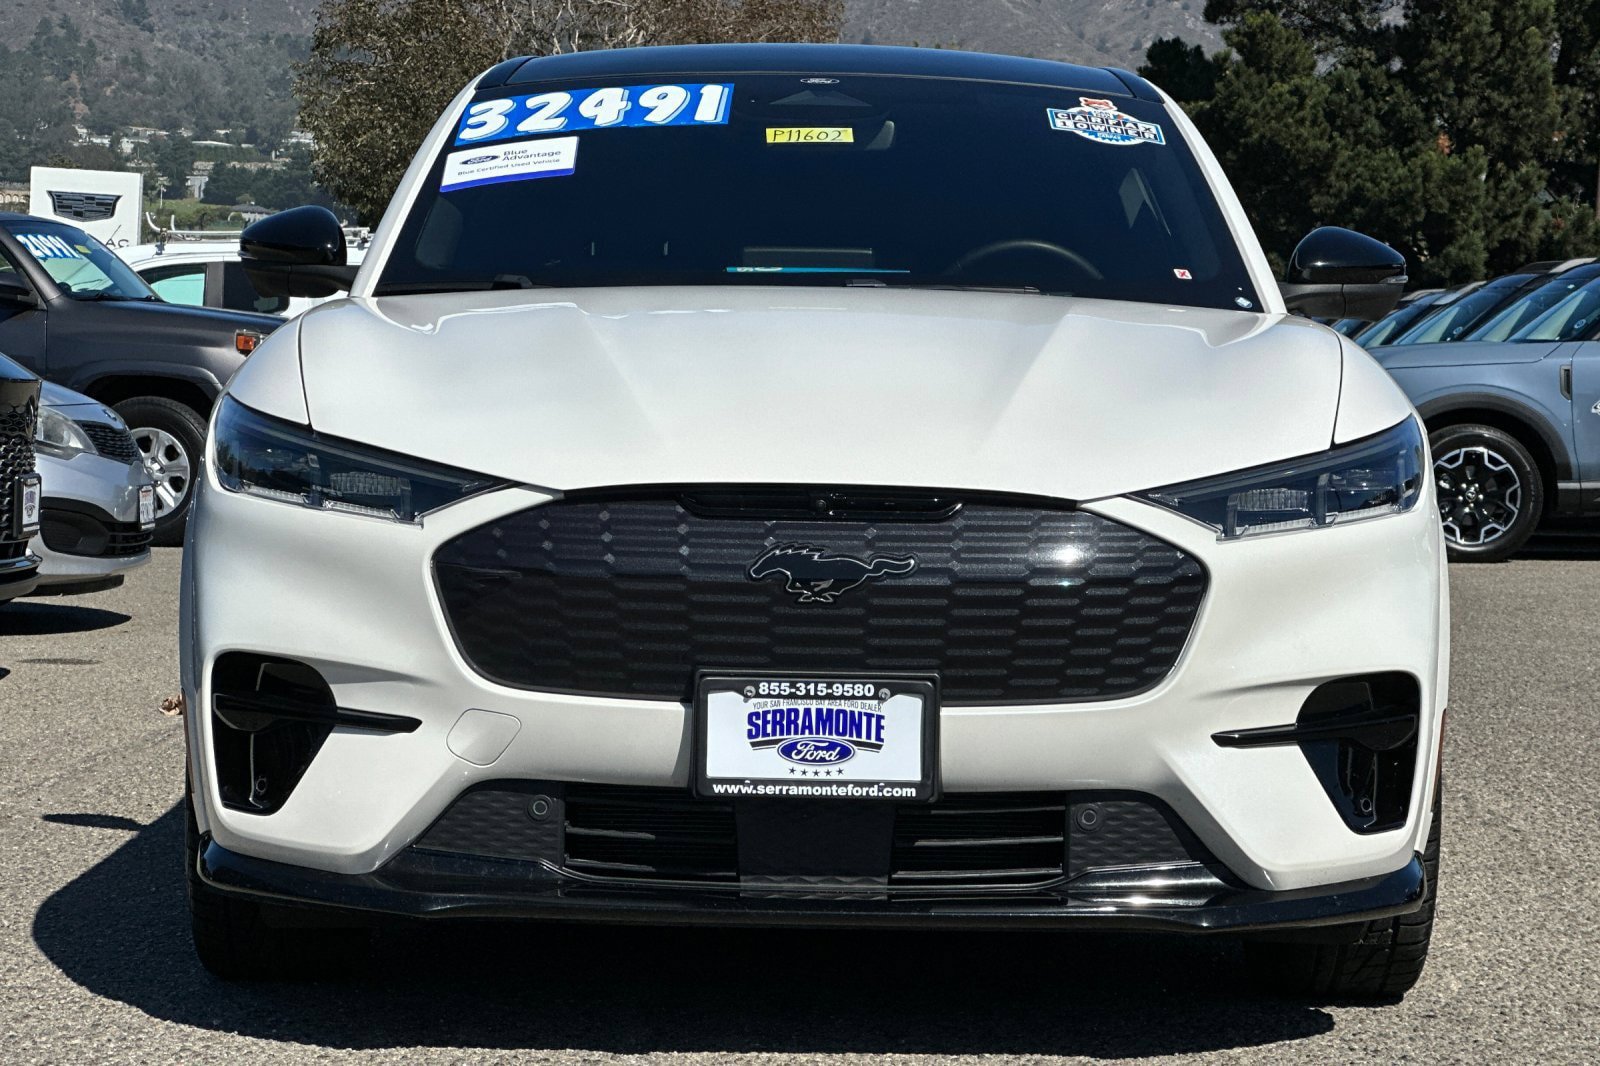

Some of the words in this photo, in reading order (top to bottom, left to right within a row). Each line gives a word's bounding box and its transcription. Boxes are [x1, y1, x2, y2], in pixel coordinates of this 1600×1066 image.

[459, 85, 729, 140] 32491
[1056, 112, 1154, 131] CARFAX
[773, 129, 842, 142] P11602
[1076, 122, 1158, 140] OWNER
[502, 151, 562, 161] Advantage
[476, 164, 509, 173] Certified
[758, 682, 875, 697] 855-315-9580
[753, 700, 769, 710] YOUR
[769, 699, 780, 708] SAN
[827, 699, 842, 707] AREA
[843, 700, 859, 709] FORD
[860, 701, 882, 713] DEALER
[747, 707, 886, 743] SERRAMONTE
[791, 739, 841, 762] Ford
[713, 783, 917, 798] www.serramonteford.com
